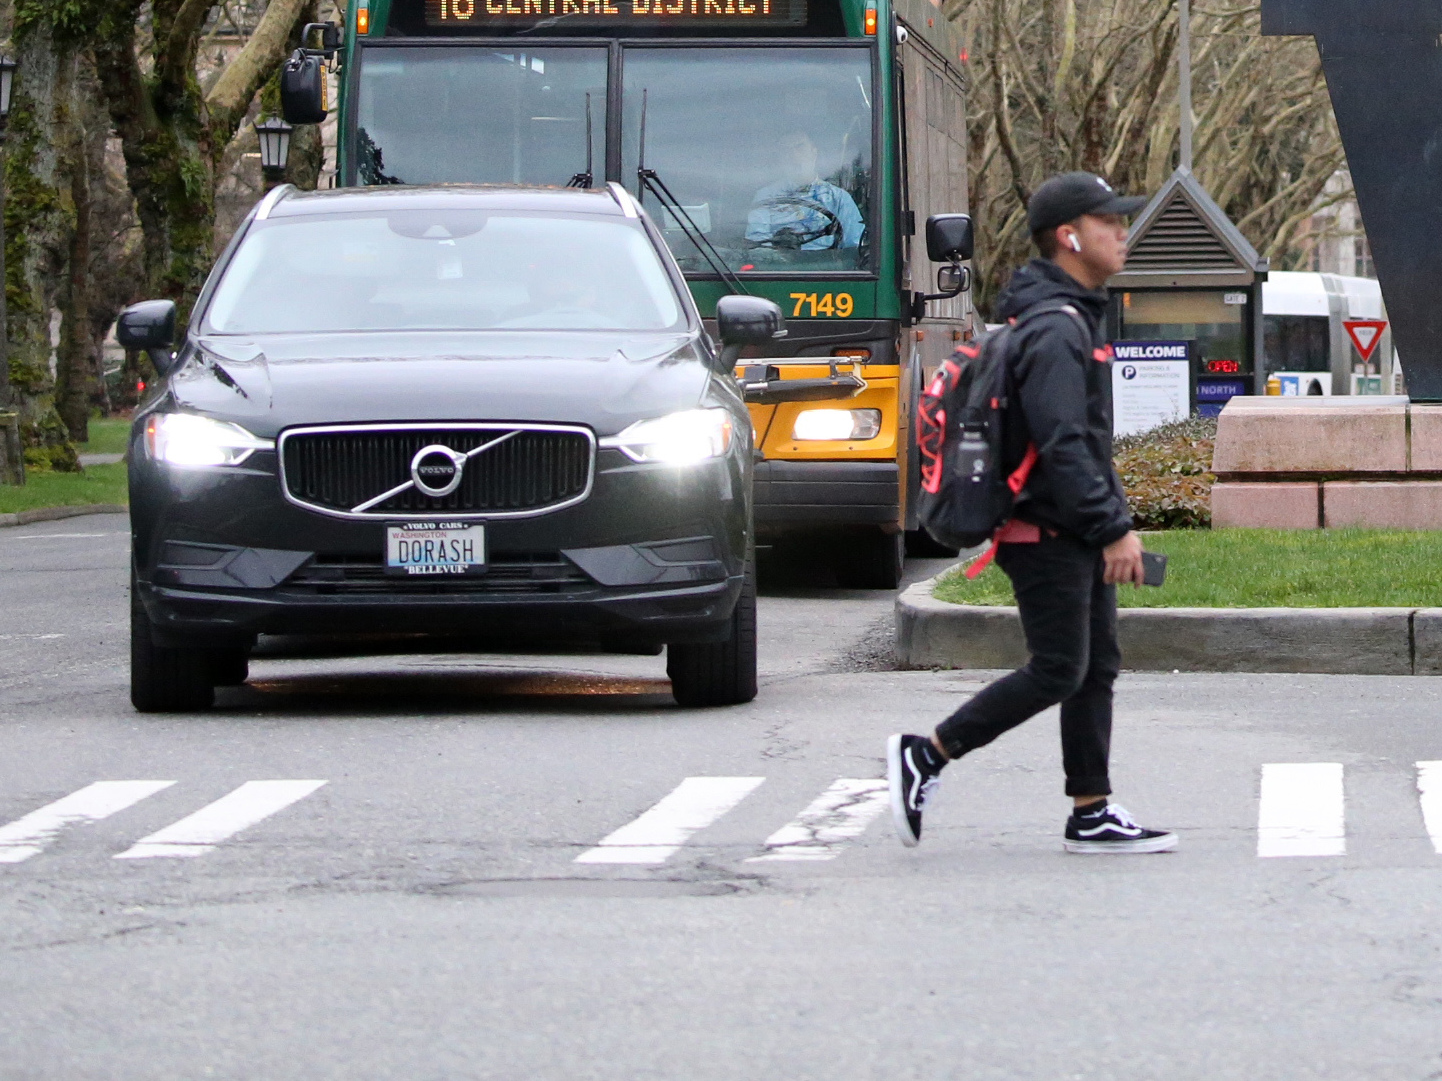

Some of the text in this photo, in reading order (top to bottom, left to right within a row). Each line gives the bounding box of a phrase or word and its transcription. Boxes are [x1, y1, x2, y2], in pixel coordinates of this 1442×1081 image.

[790, 293, 854, 317] 7149
[1116, 346, 1185, 358] WELCOME
[1208, 360, 1238, 372] OPEN
[1201, 385, 1236, 395] NORTH
[392, 531, 447, 539] WASHINGTON
[399, 539, 474, 563] DORASH
